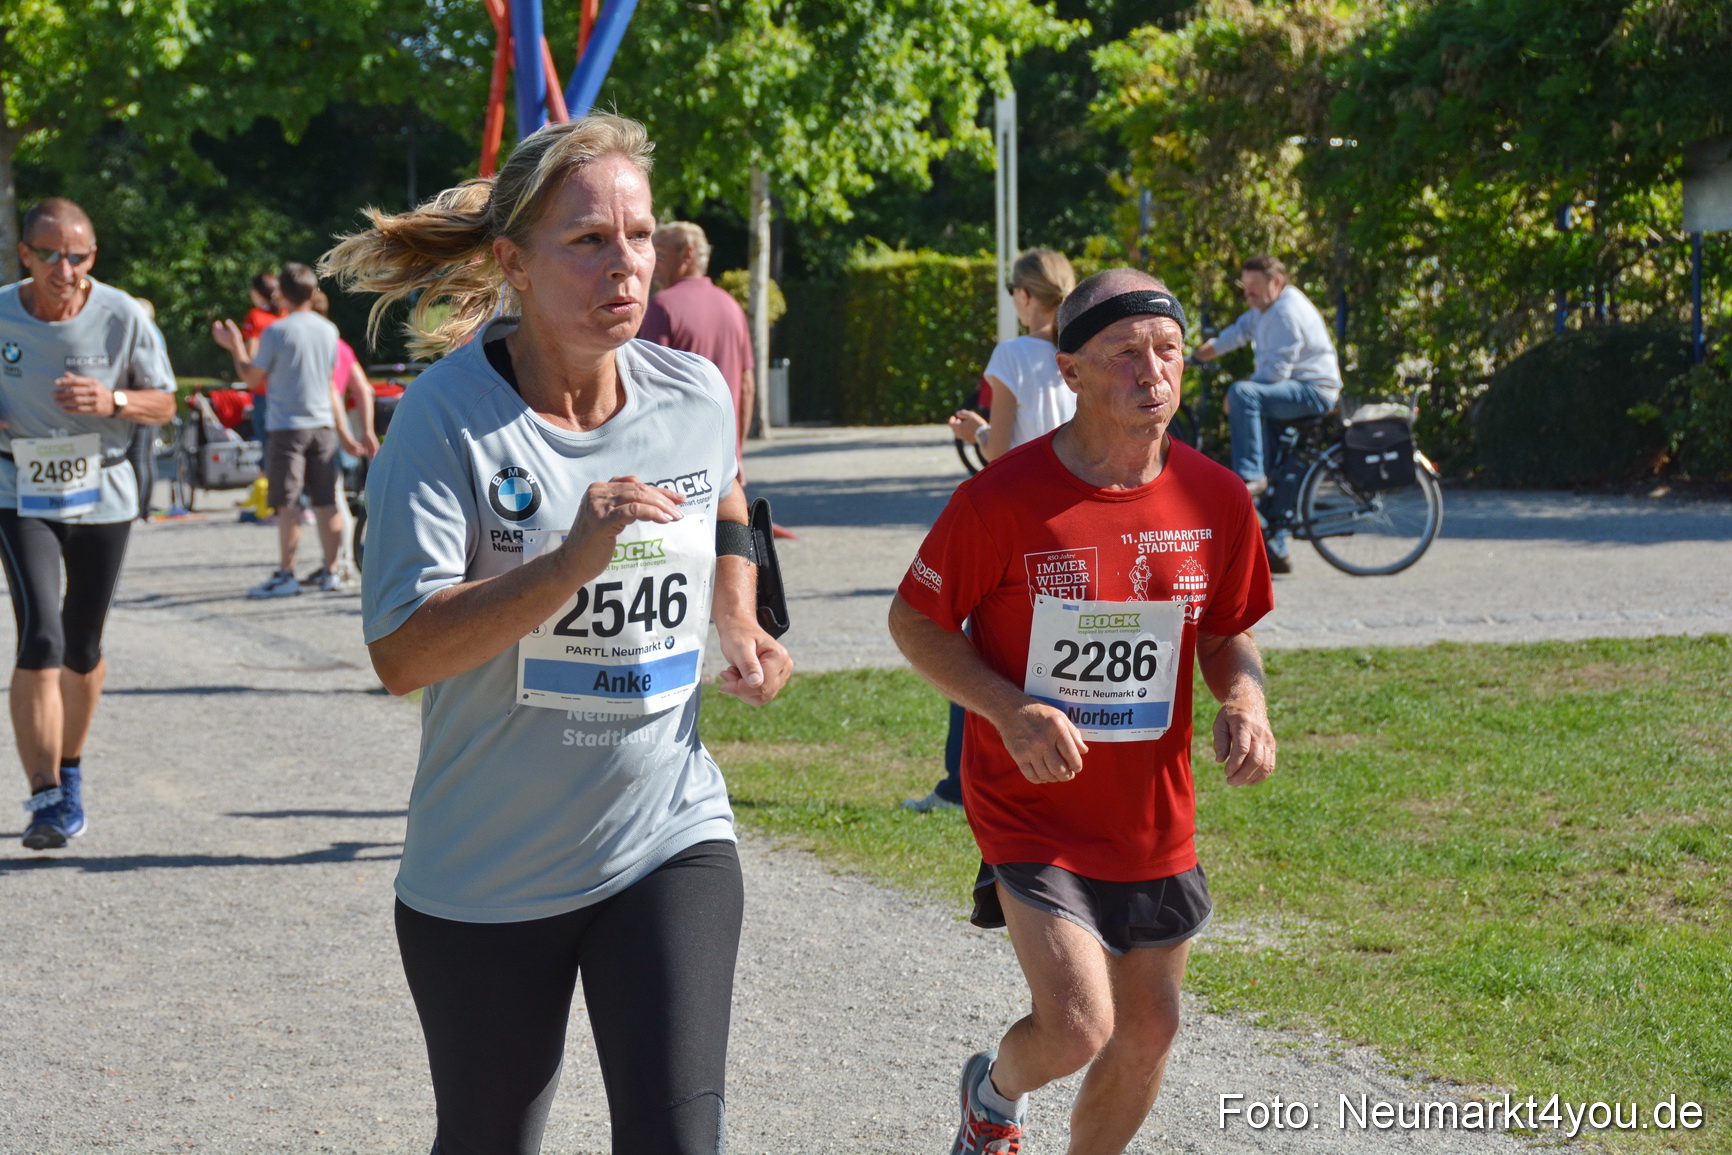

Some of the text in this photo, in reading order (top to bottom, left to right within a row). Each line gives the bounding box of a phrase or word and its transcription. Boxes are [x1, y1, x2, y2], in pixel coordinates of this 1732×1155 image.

[29, 457, 88, 483] 2489
[491, 467, 537, 487] BMW
[645, 469, 712, 498] OCK
[490, 529, 526, 543] PAR
[1120, 529, 1212, 545] 11. NEUMARKTER
[610, 538, 665, 563] OCK
[1138, 541, 1200, 554] STADTLAUF
[1037, 560, 1087, 574] IMMER
[1035, 572, 1090, 586] WIEDER
[553, 573, 687, 638] 2546
[1079, 613, 1141, 629] BOCK
[566, 641, 661, 658] PARTL Neumarkt
[1050, 639, 1158, 683] 2286
[1036, 666, 1043, 675] C
[593, 670, 652, 693] Anke
[1059, 686, 1134, 698] PARTL Neumarkt
[1067, 706, 1134, 726] Norbert
